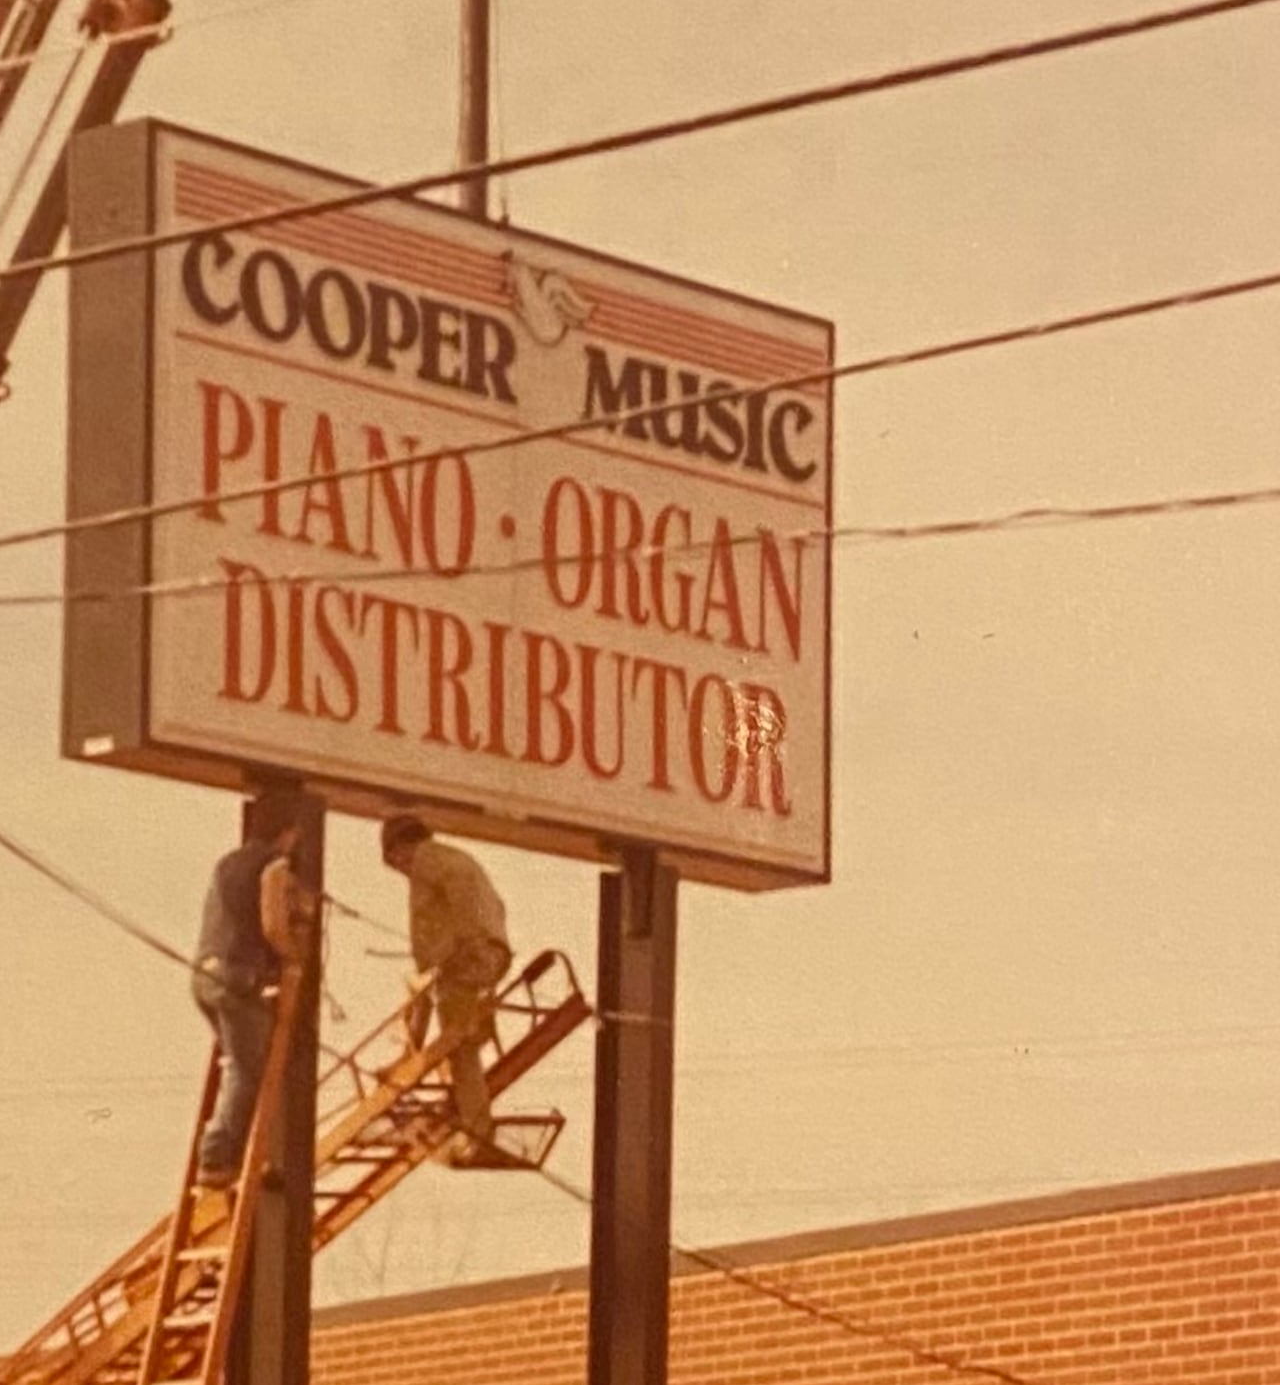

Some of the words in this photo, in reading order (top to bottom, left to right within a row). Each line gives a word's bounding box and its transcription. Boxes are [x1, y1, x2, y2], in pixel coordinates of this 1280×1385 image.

[181, 231, 518, 405] COOPER
[584, 345, 818, 482] MUSIC
[194, 381, 478, 578] PIANO
[541, 475, 803, 662] ORGAN
[217, 558, 793, 816] DISTRIBUTOR
